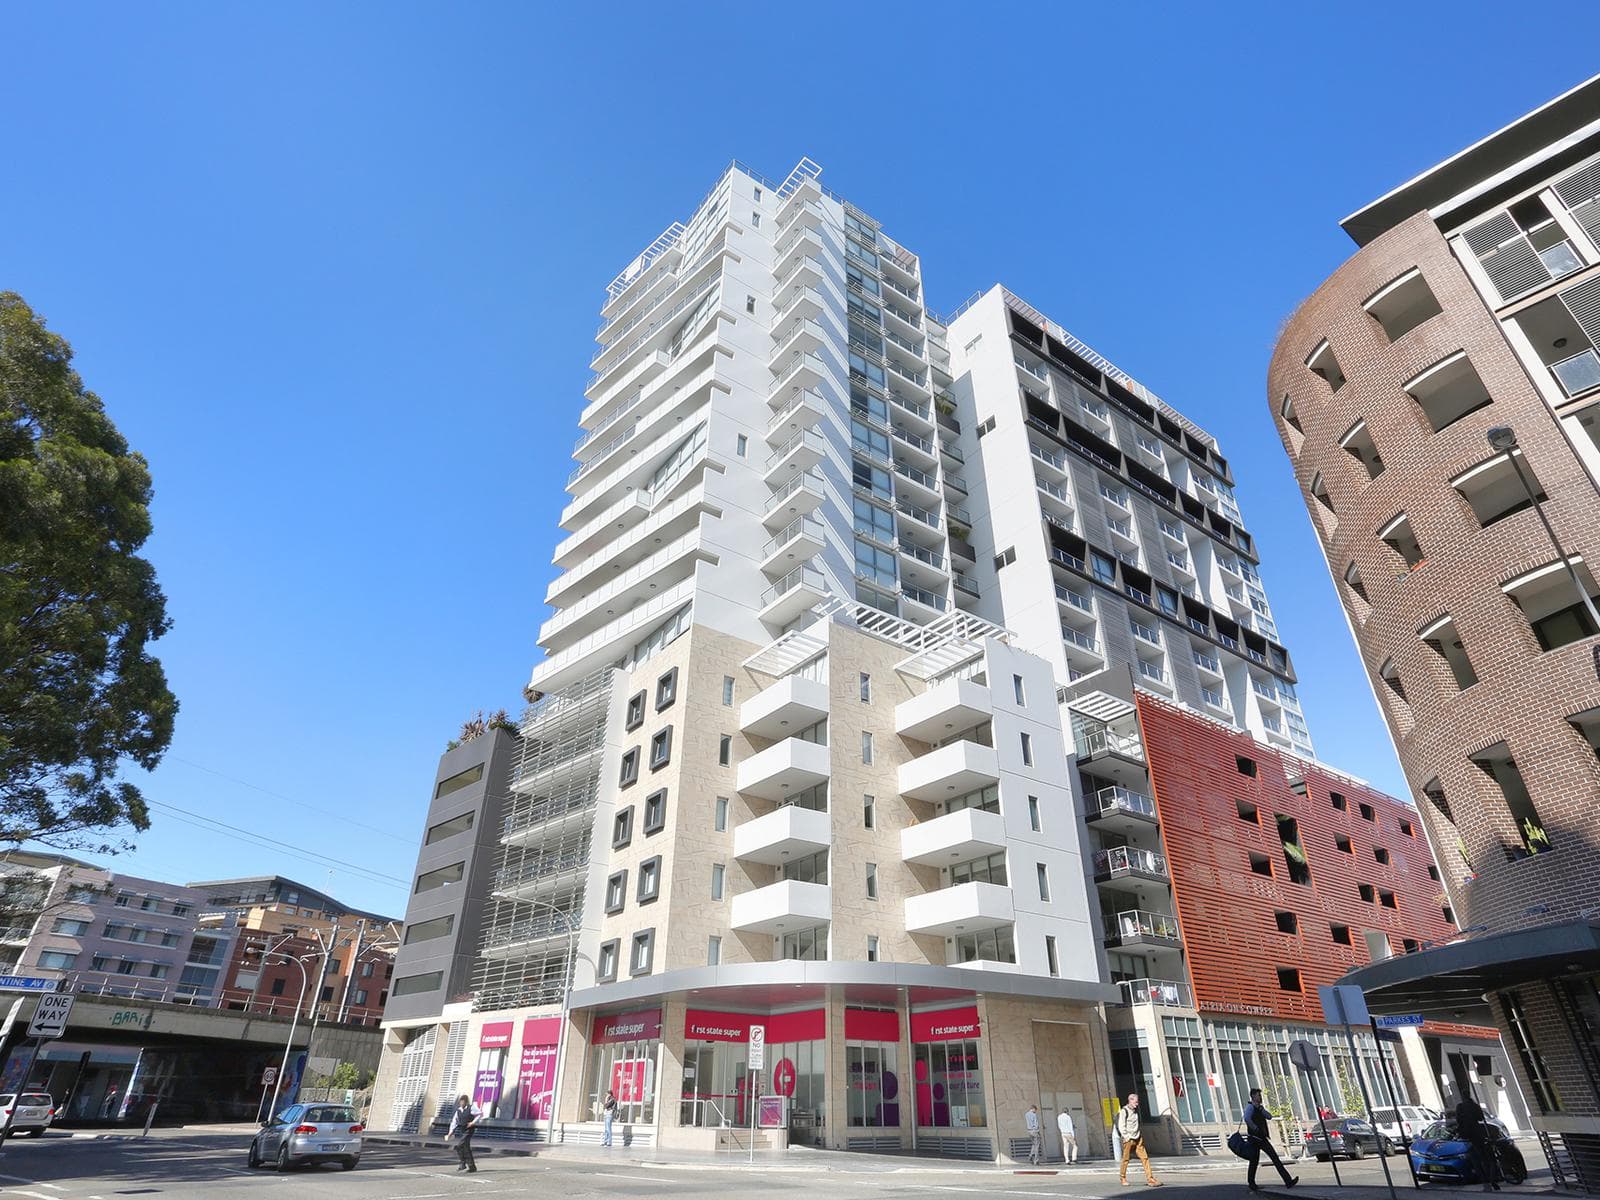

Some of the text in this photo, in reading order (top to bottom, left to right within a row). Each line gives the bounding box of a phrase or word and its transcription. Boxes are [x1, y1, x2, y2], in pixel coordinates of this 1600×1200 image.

[30, 979, 43, 987] AV
[44, 996, 70, 1008] ONE
[38, 1009, 66, 1020] WAY
[1384, 1015, 1421, 1025] PARKES ST
[616, 1024, 628, 1035] state
[629, 1023, 645, 1036] super
[706, 1027, 722, 1035] state
[723, 1029, 741, 1038] super
[943, 1026, 957, 1034] state
[958, 1025, 974, 1034] super
